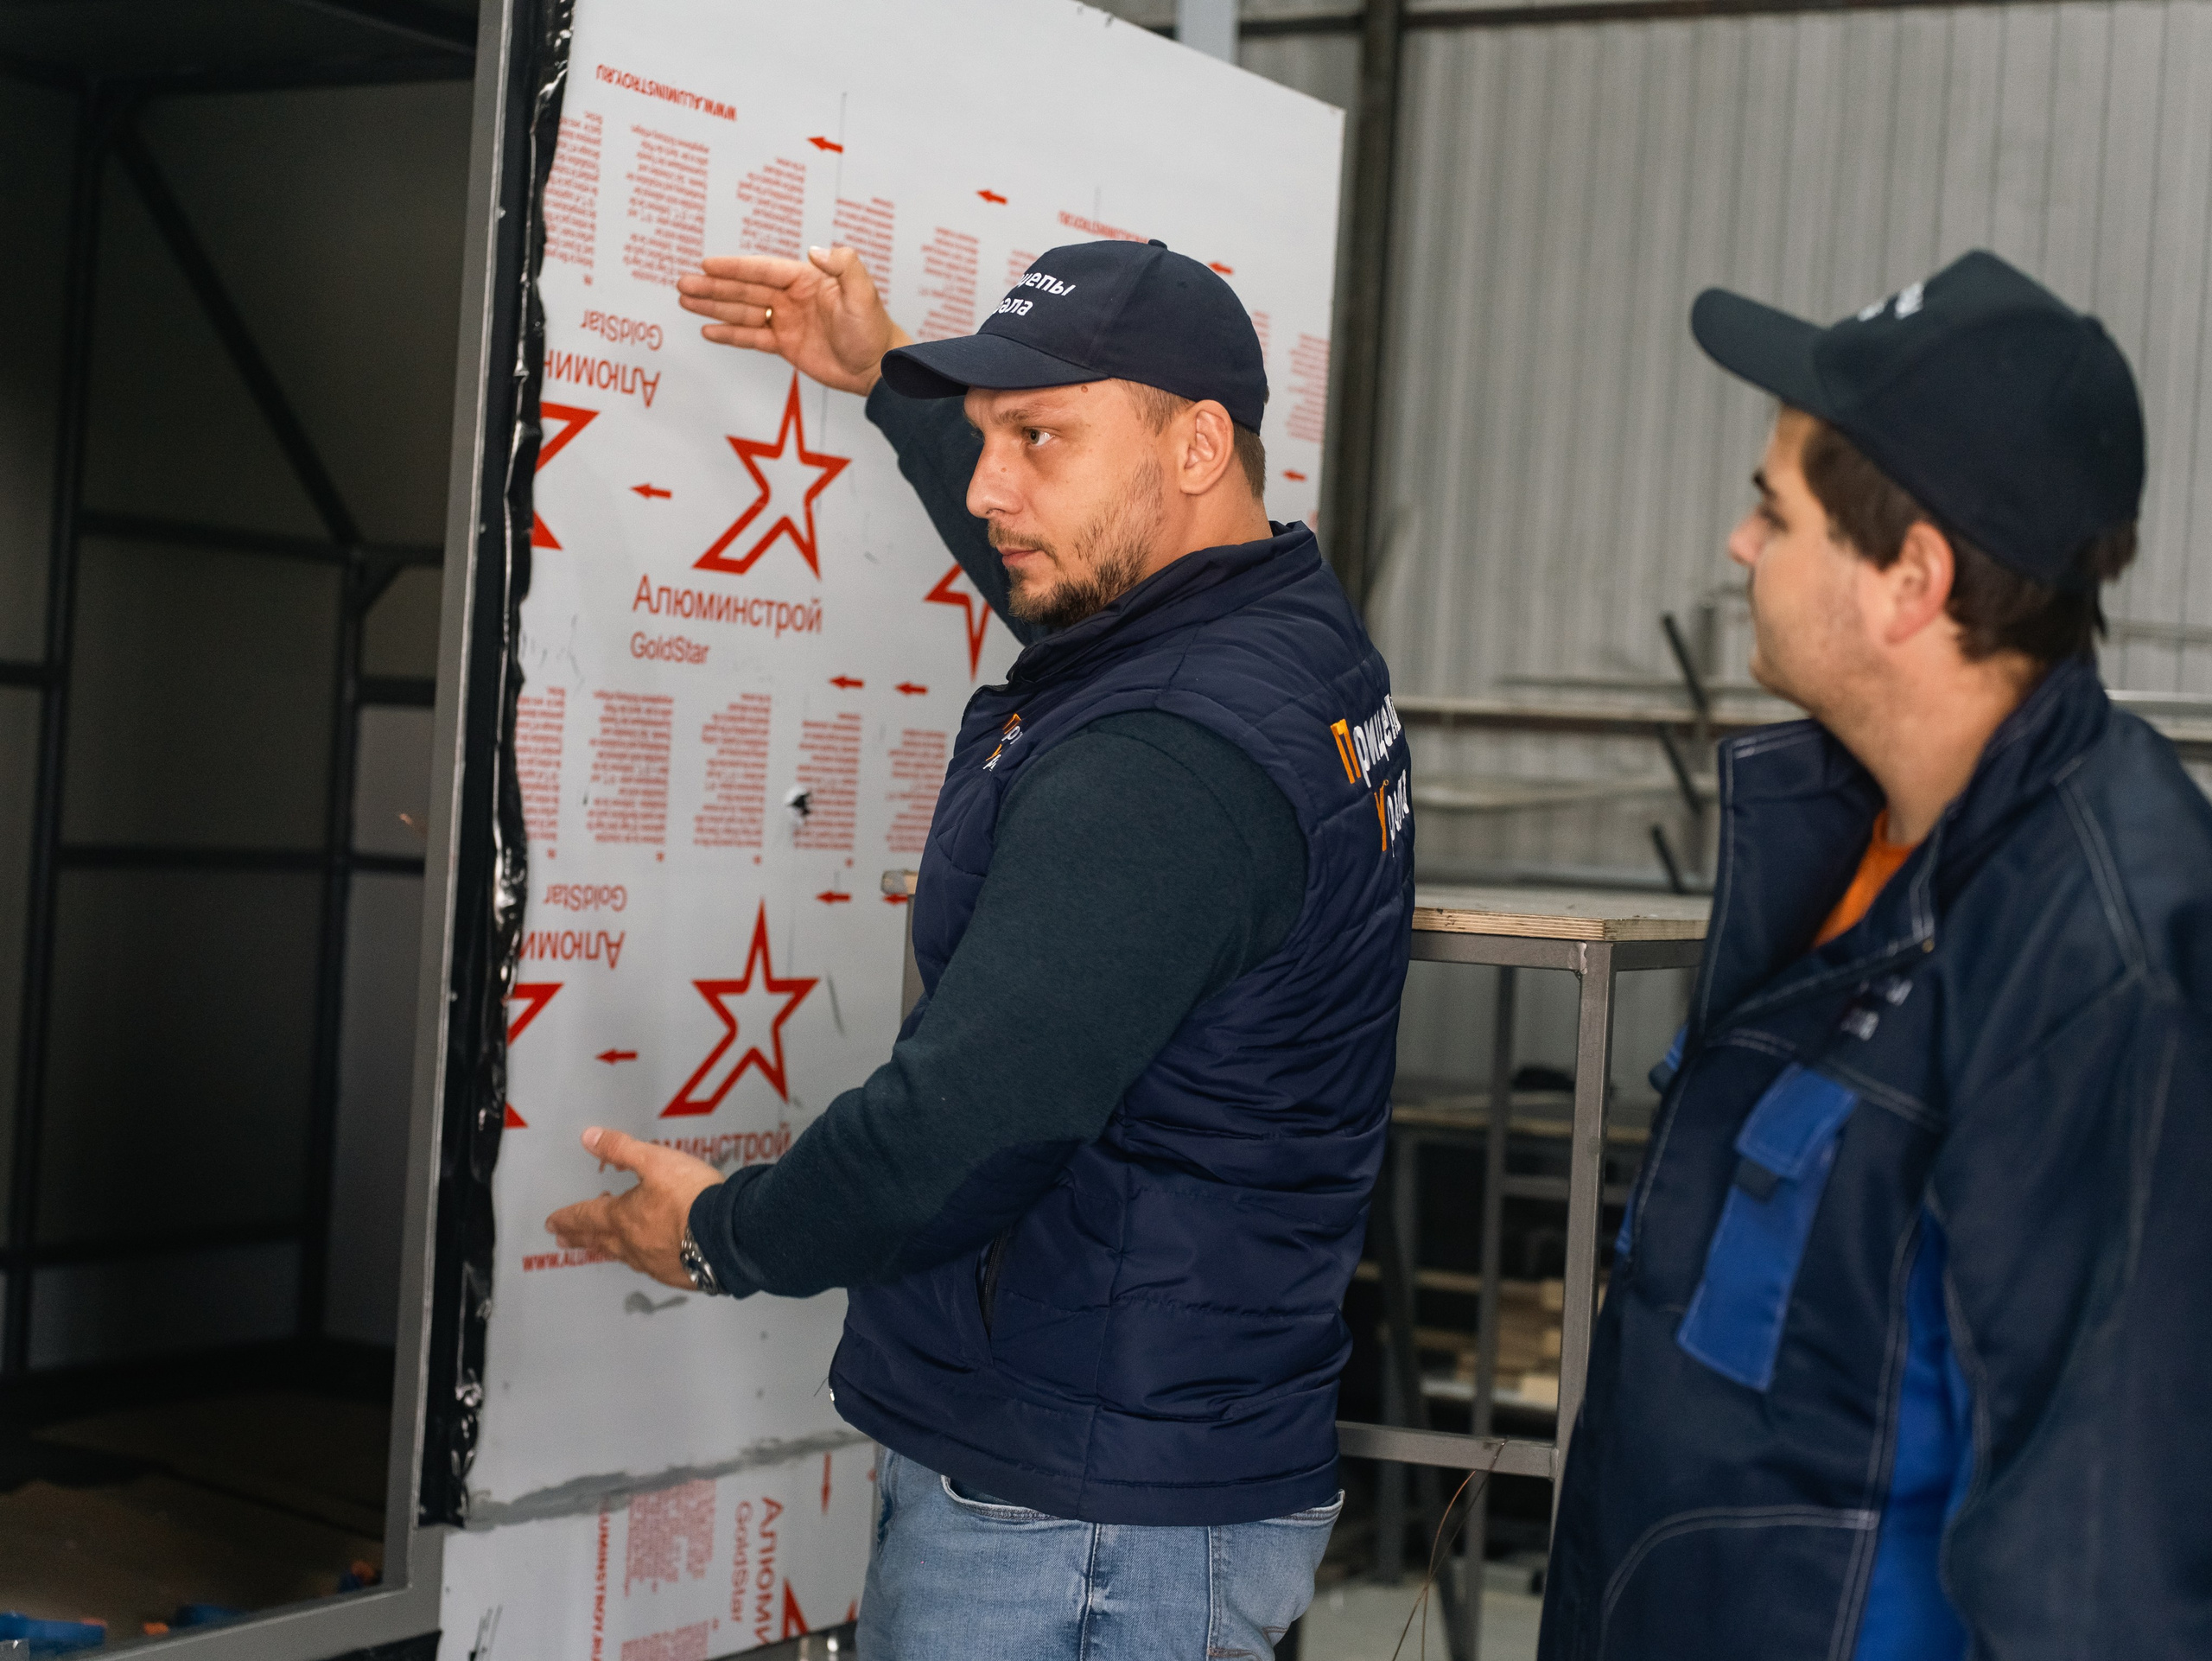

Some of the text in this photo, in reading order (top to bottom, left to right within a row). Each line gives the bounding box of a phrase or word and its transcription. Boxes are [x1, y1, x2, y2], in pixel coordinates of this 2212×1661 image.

[1017, 271, 1076, 296] цепы
[993, 297, 1034, 316] ала
[580, 310, 663, 352] GoldStar
[632, 573, 823, 636] Алюминстрой
[631, 631, 710, 665] GoldStar
[543, 883, 628, 913] GoldStar
[731, 1502, 752, 1622] GoldStar
